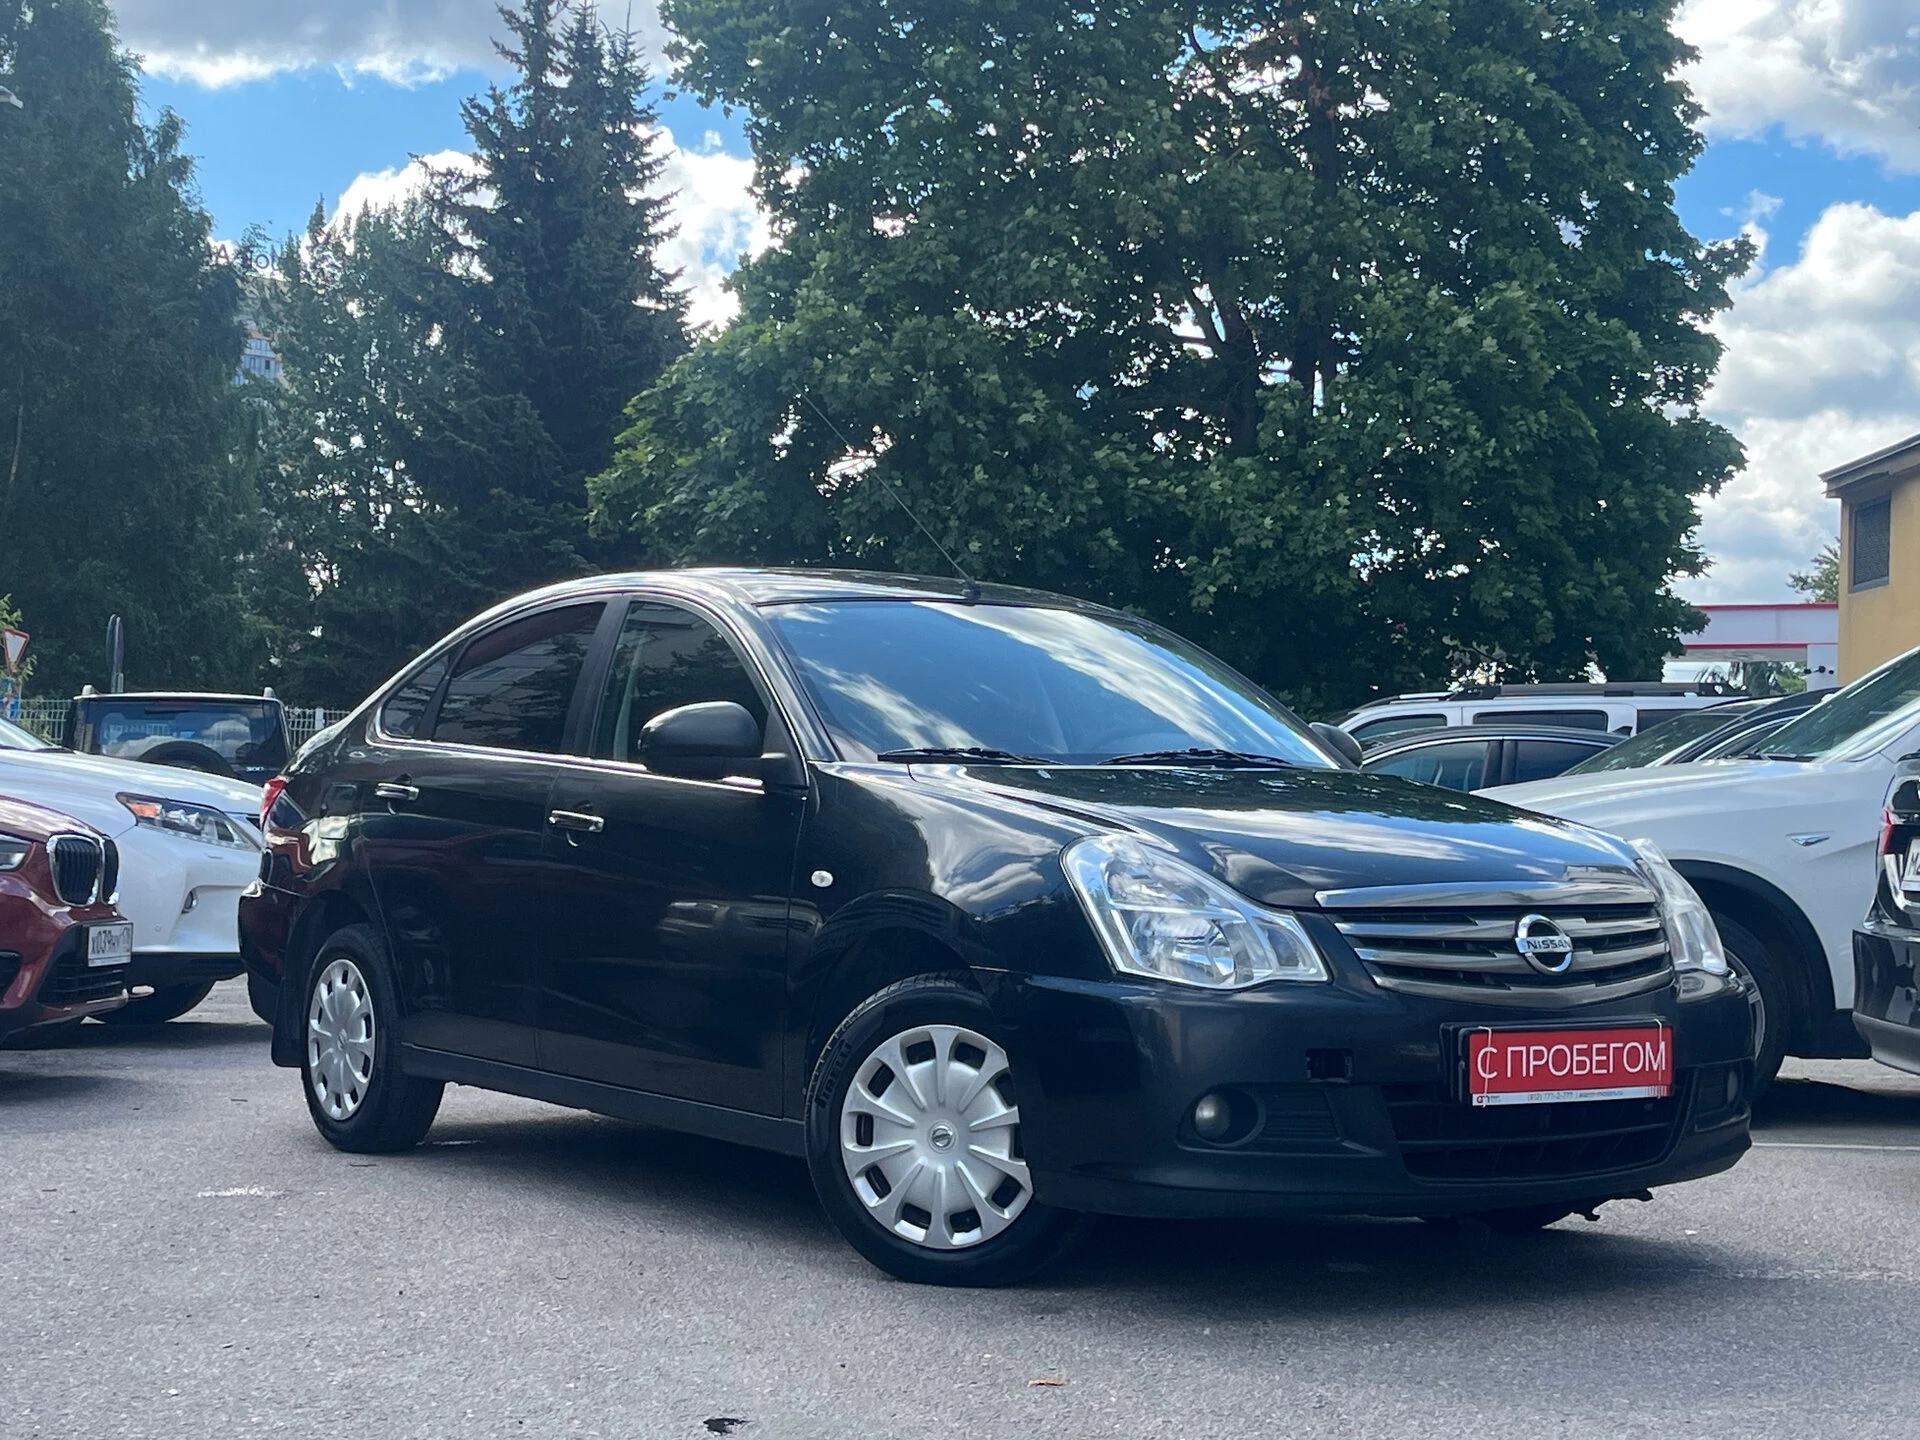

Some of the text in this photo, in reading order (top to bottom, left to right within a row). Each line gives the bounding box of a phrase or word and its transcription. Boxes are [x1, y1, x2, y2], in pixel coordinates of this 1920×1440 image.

[1526, 939, 1572, 950] NISSAN
[1477, 1041, 1666, 1079] С ПРОБЕГОМ
